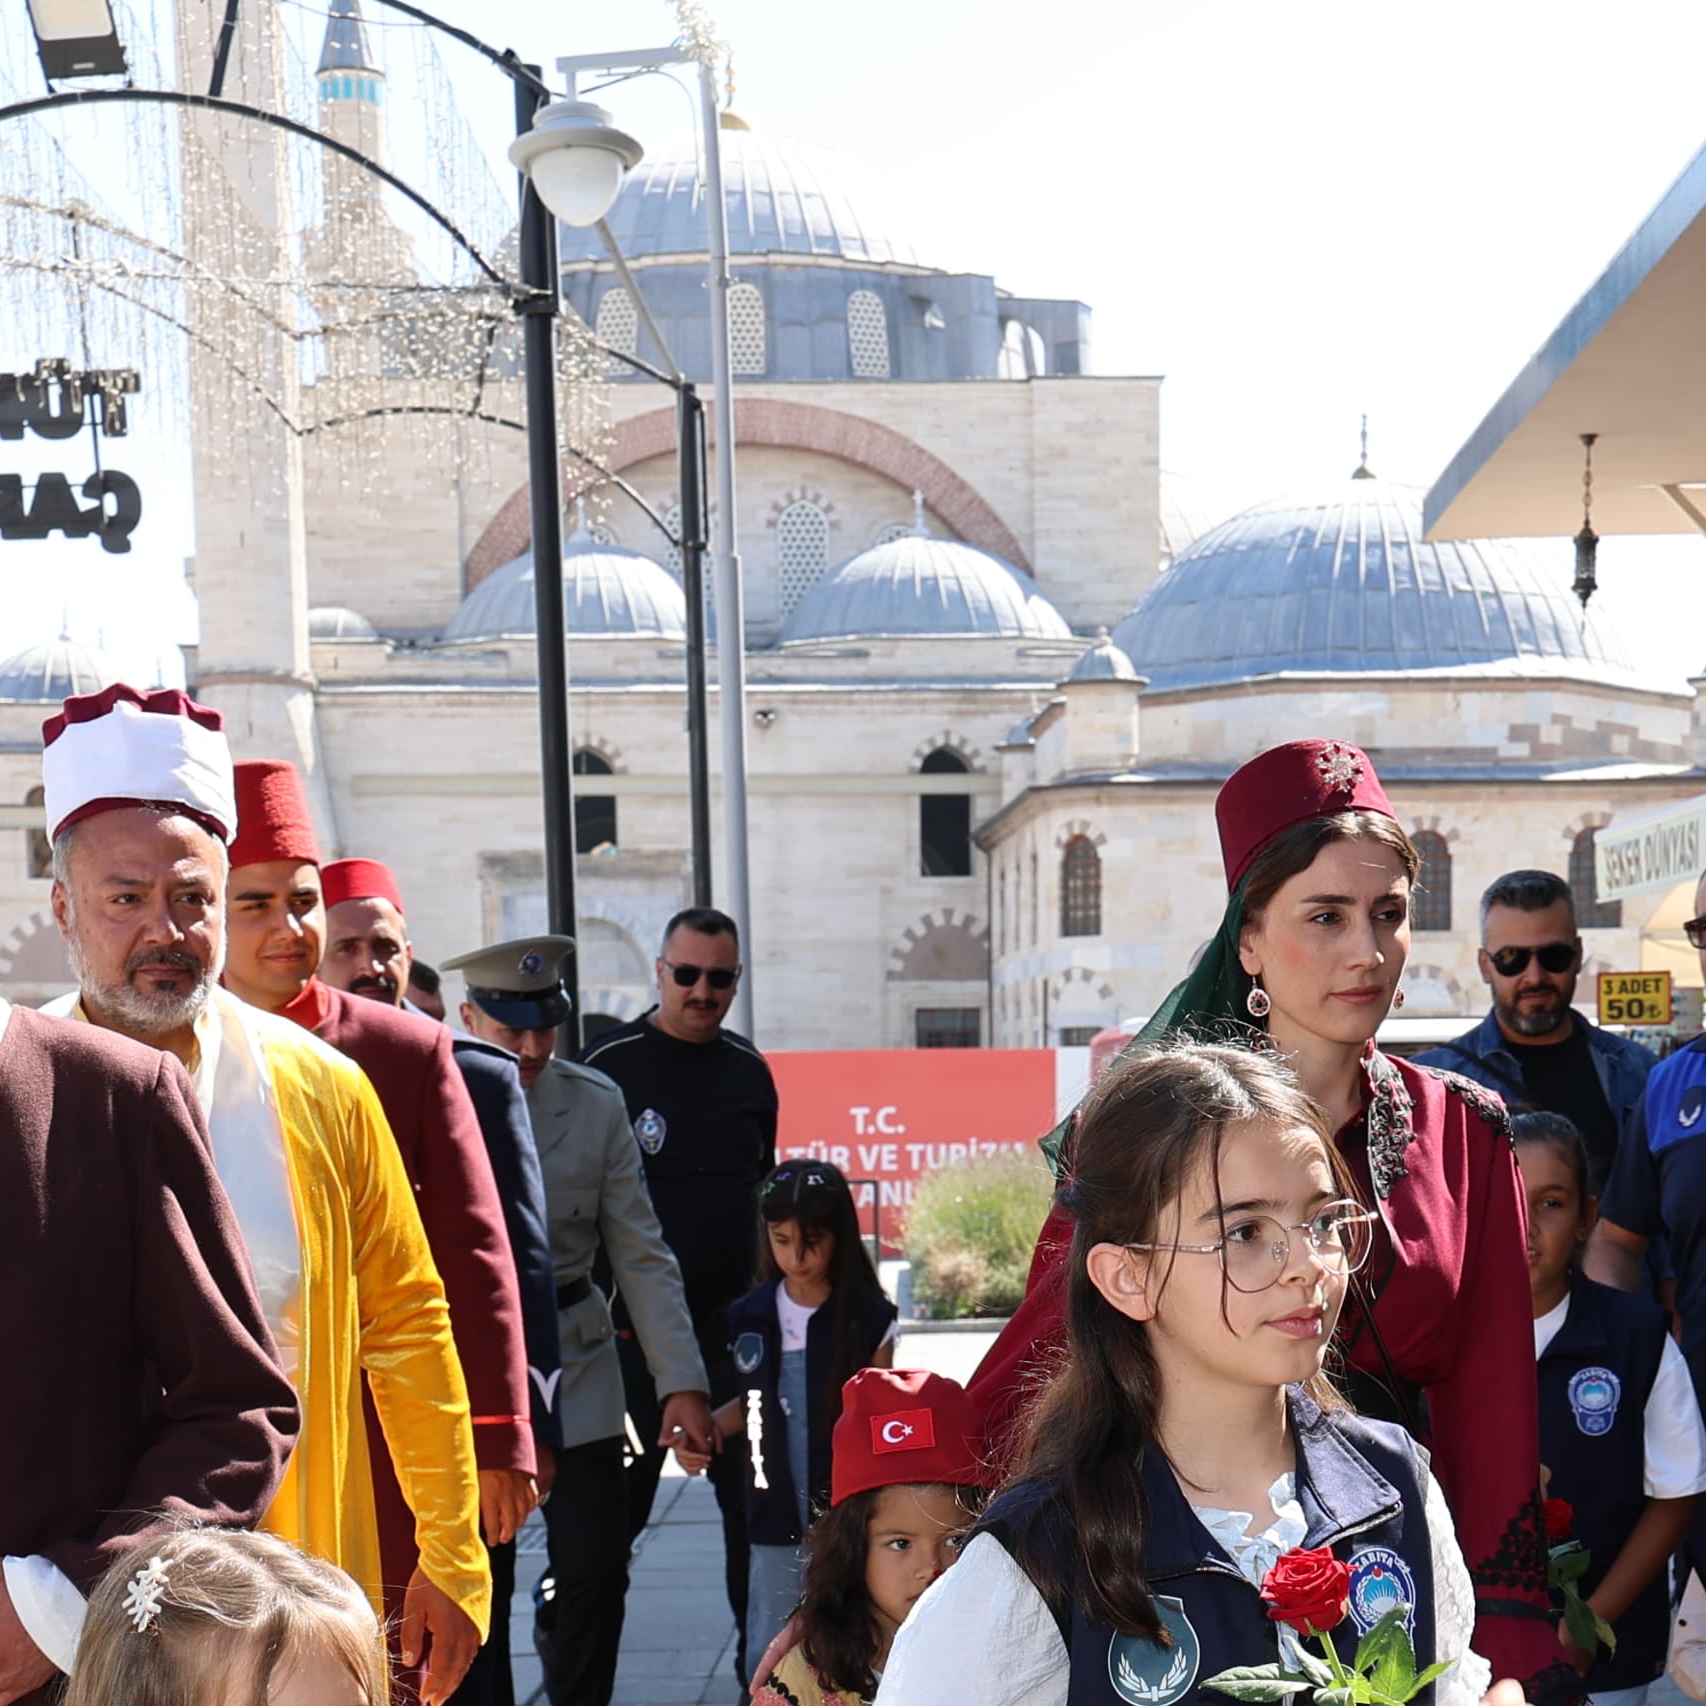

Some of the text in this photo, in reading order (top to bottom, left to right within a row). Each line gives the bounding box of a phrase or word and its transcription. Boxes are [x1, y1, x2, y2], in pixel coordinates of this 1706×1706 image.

[1645, 820, 1700, 881] DÜNYASI
[1604, 978, 1662, 995] 3 ADET
[849, 1105, 907, 1135] T.C.
[858, 1144, 901, 1172] VE
